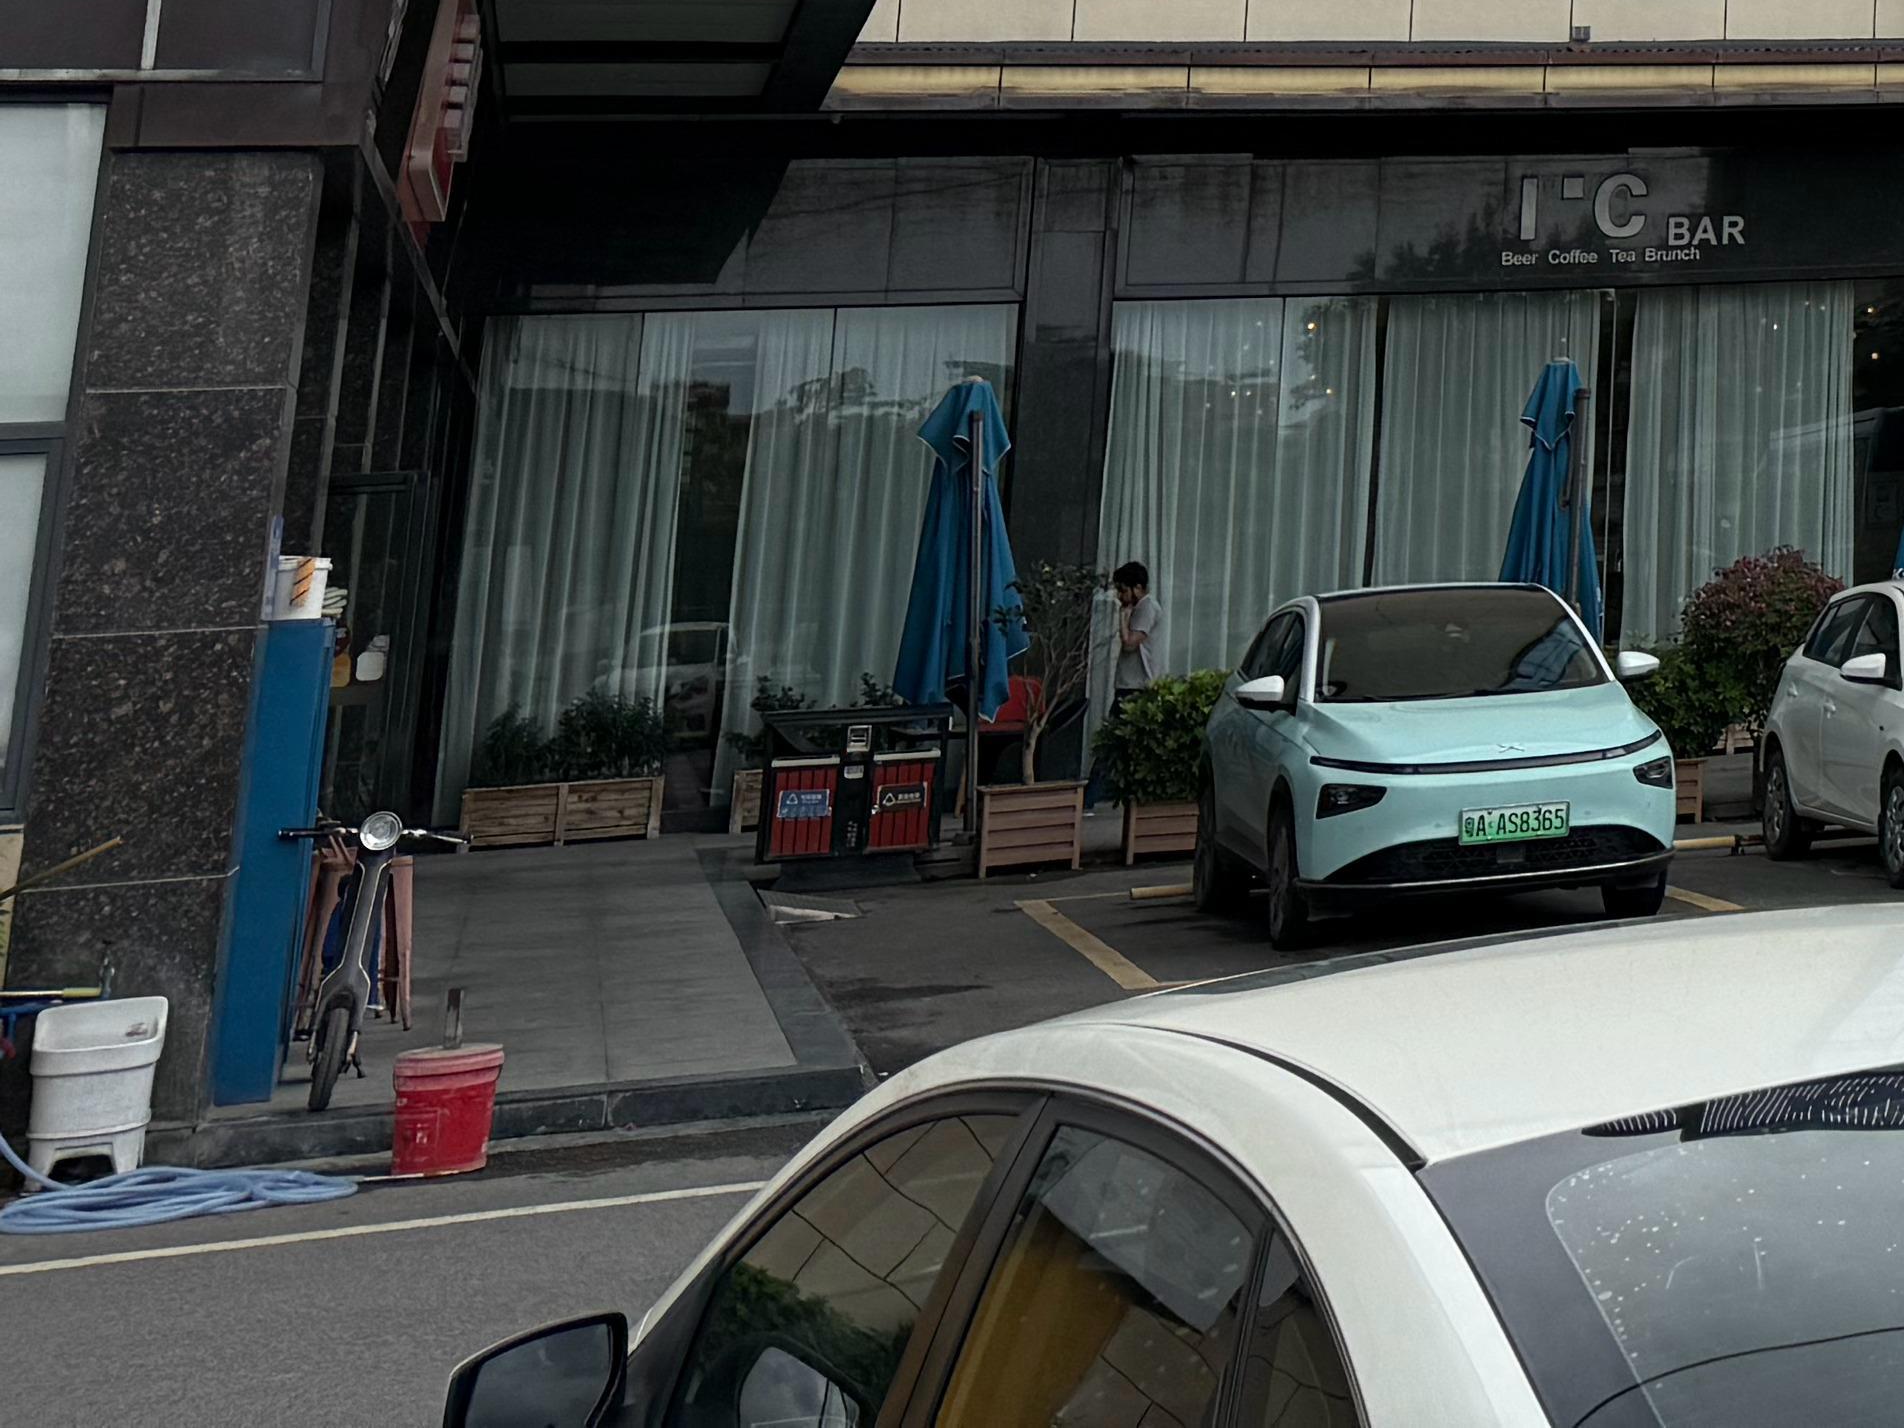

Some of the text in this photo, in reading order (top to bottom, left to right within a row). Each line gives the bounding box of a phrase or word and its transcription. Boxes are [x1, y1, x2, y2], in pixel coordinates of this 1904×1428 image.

[1667, 215, 1746, 246] BAR
[1501, 246, 1700, 267] Beer Coffee Tea Brunch
